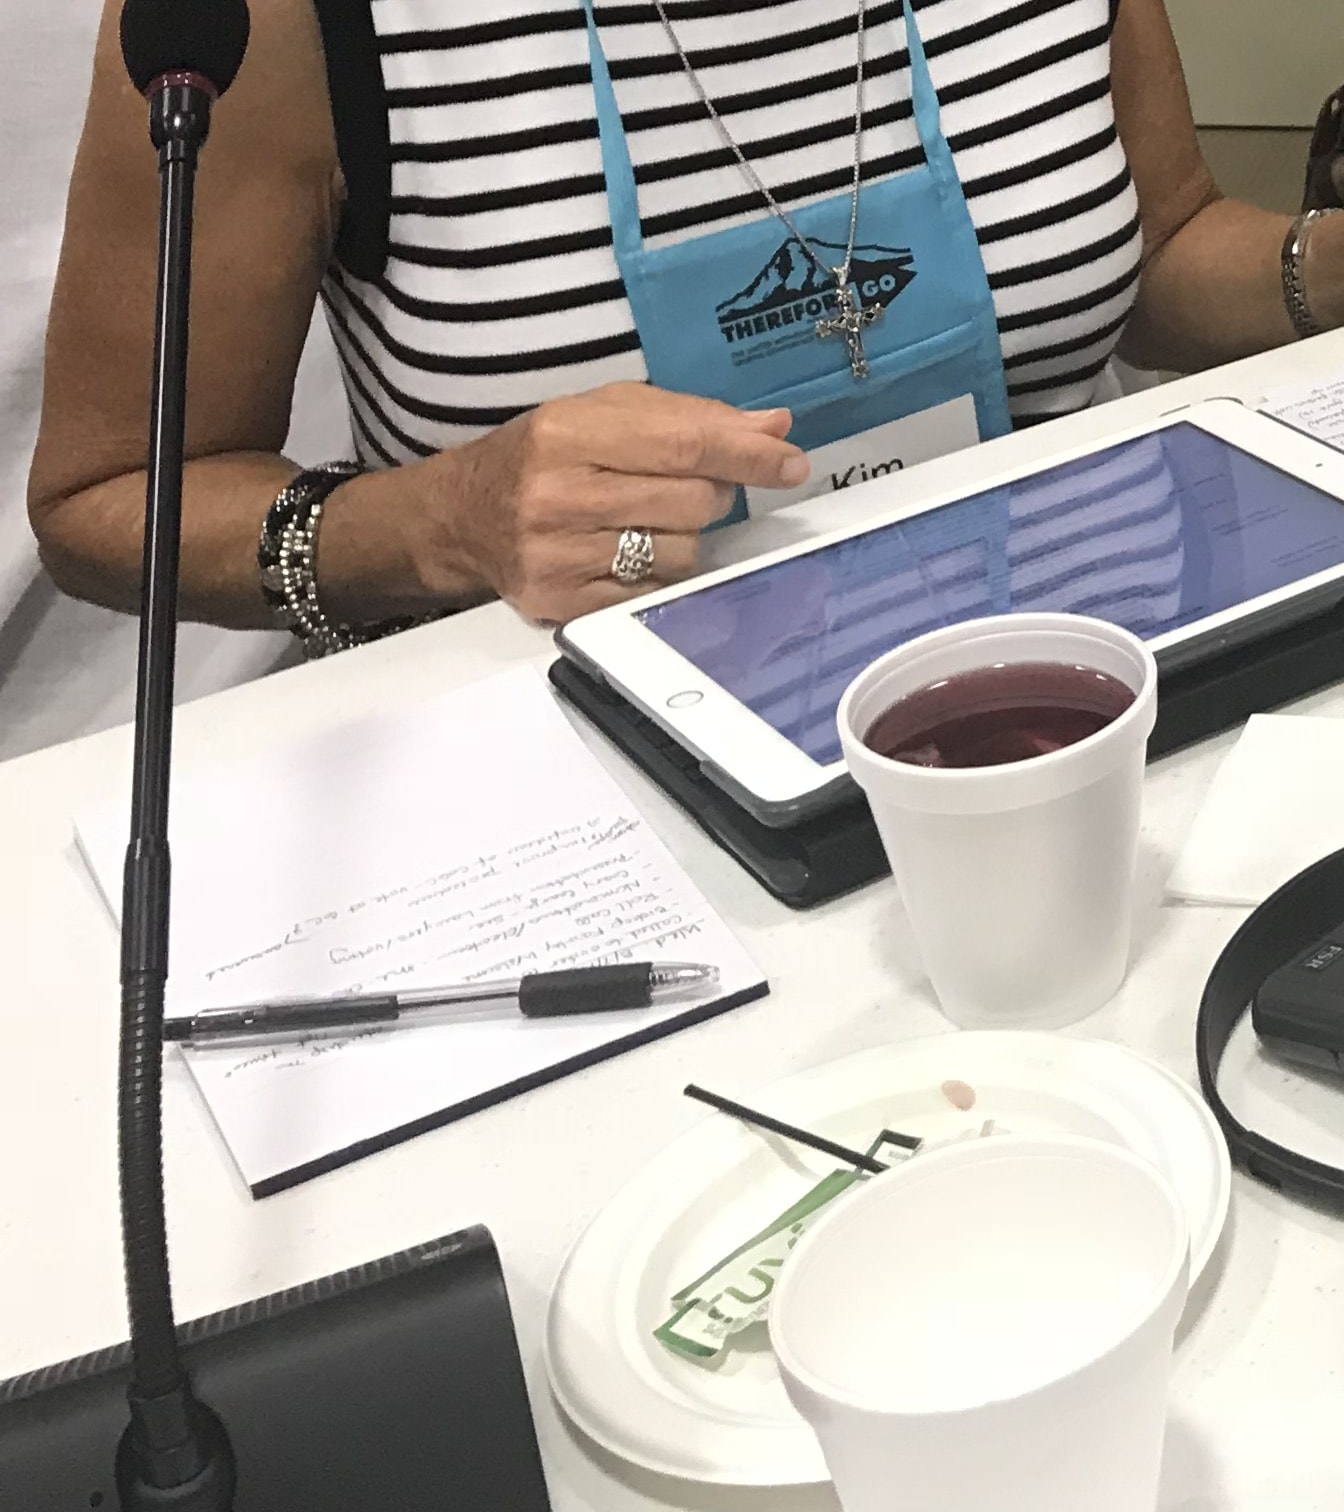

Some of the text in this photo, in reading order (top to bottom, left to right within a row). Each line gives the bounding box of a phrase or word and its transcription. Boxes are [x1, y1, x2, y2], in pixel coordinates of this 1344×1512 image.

[862, 274, 896, 297] GO
[721, 292, 848, 342] THEREFOR
[832, 459, 903, 490] Kim
